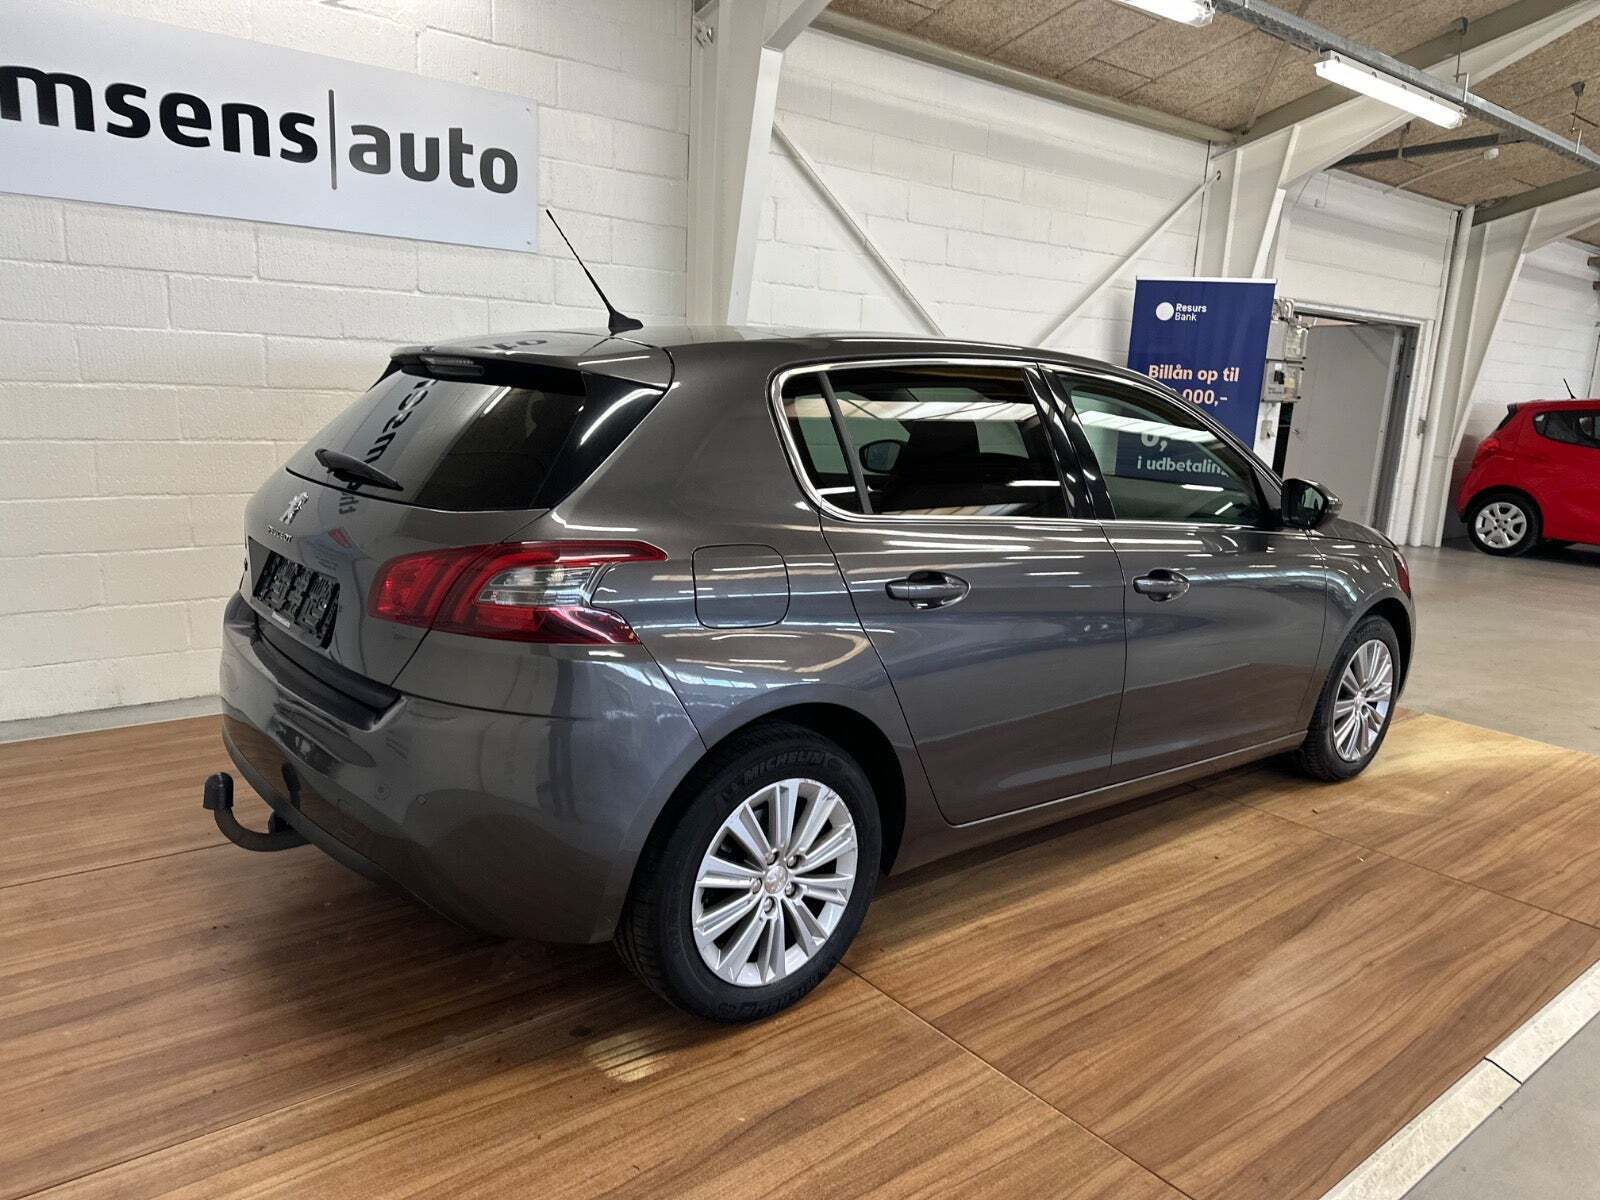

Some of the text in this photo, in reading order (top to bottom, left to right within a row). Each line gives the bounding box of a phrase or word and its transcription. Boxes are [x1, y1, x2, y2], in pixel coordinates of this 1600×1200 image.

[348, 126, 519, 194] auto
[1175, 303, 1207, 313] Resurs
[1174, 312, 1197, 321] Bank
[1148, 364, 1240, 384] Billån op til
[1137, 456, 1142, 470] i
